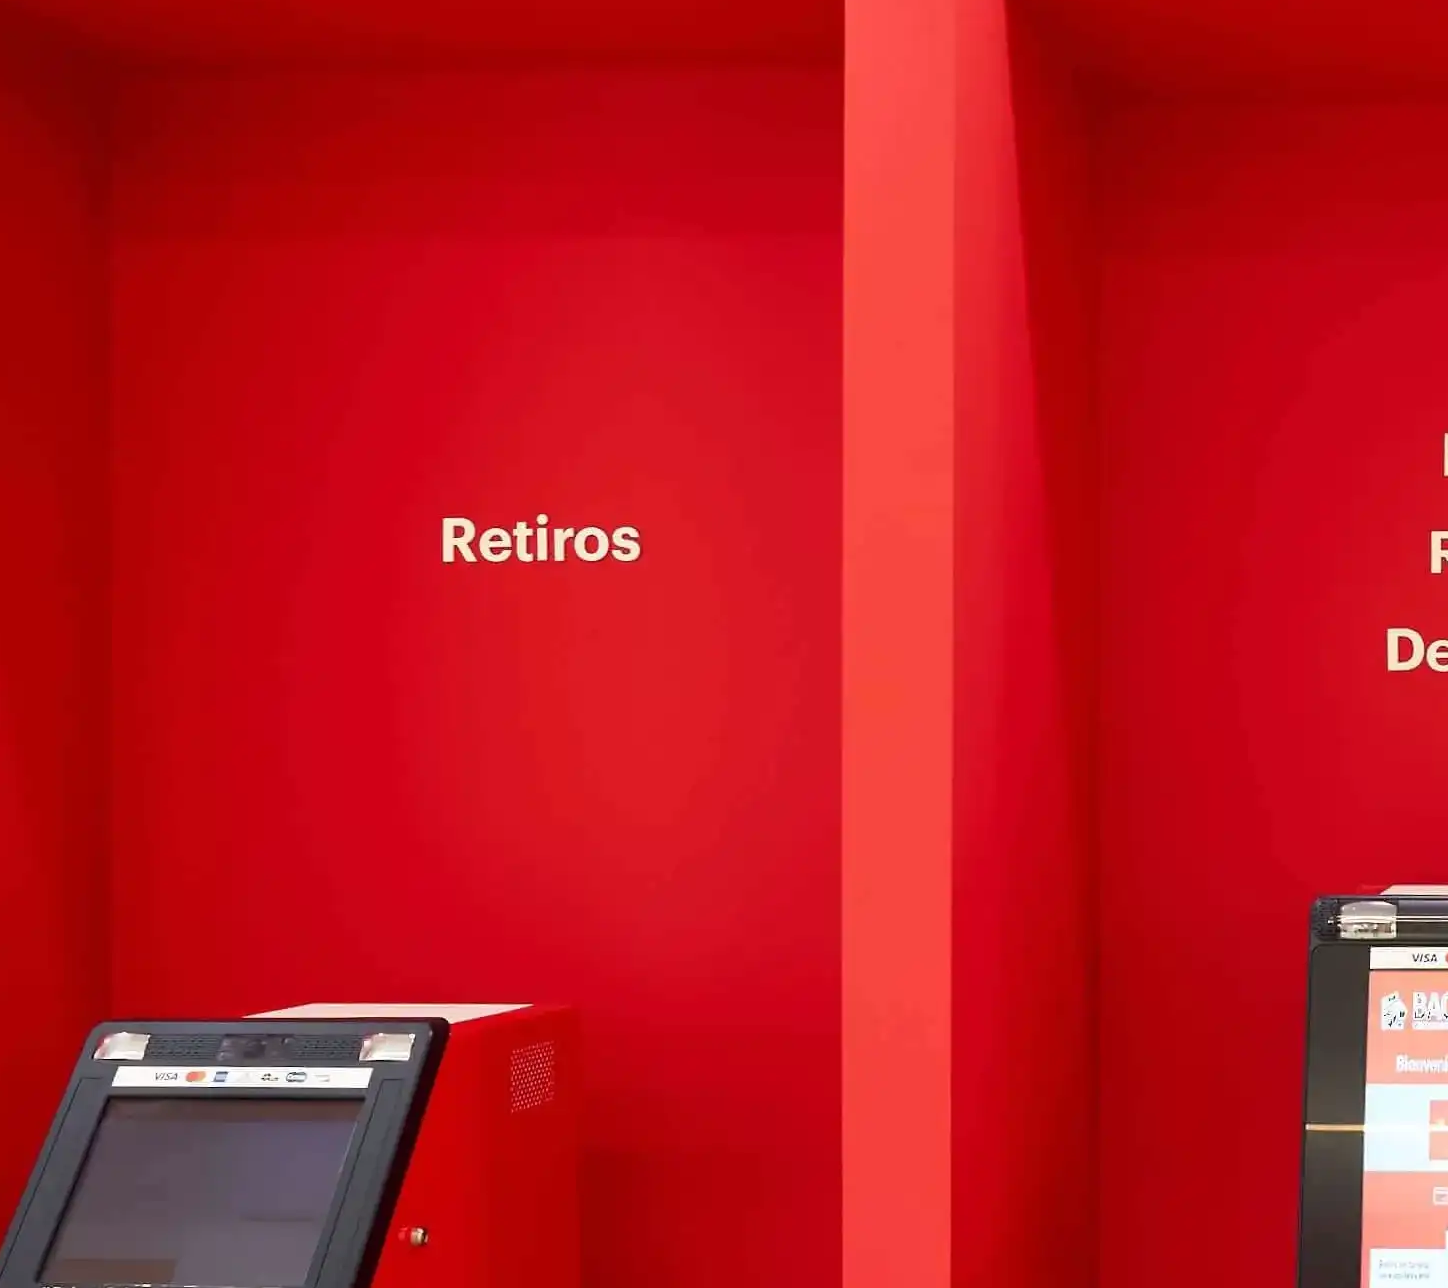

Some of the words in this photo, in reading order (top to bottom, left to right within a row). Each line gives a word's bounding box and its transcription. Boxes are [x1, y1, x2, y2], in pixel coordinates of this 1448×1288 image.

[441, 513, 641, 563] Retiros
[1412, 953, 1438, 963] VISA
[154, 1072, 179, 1082] VISA
